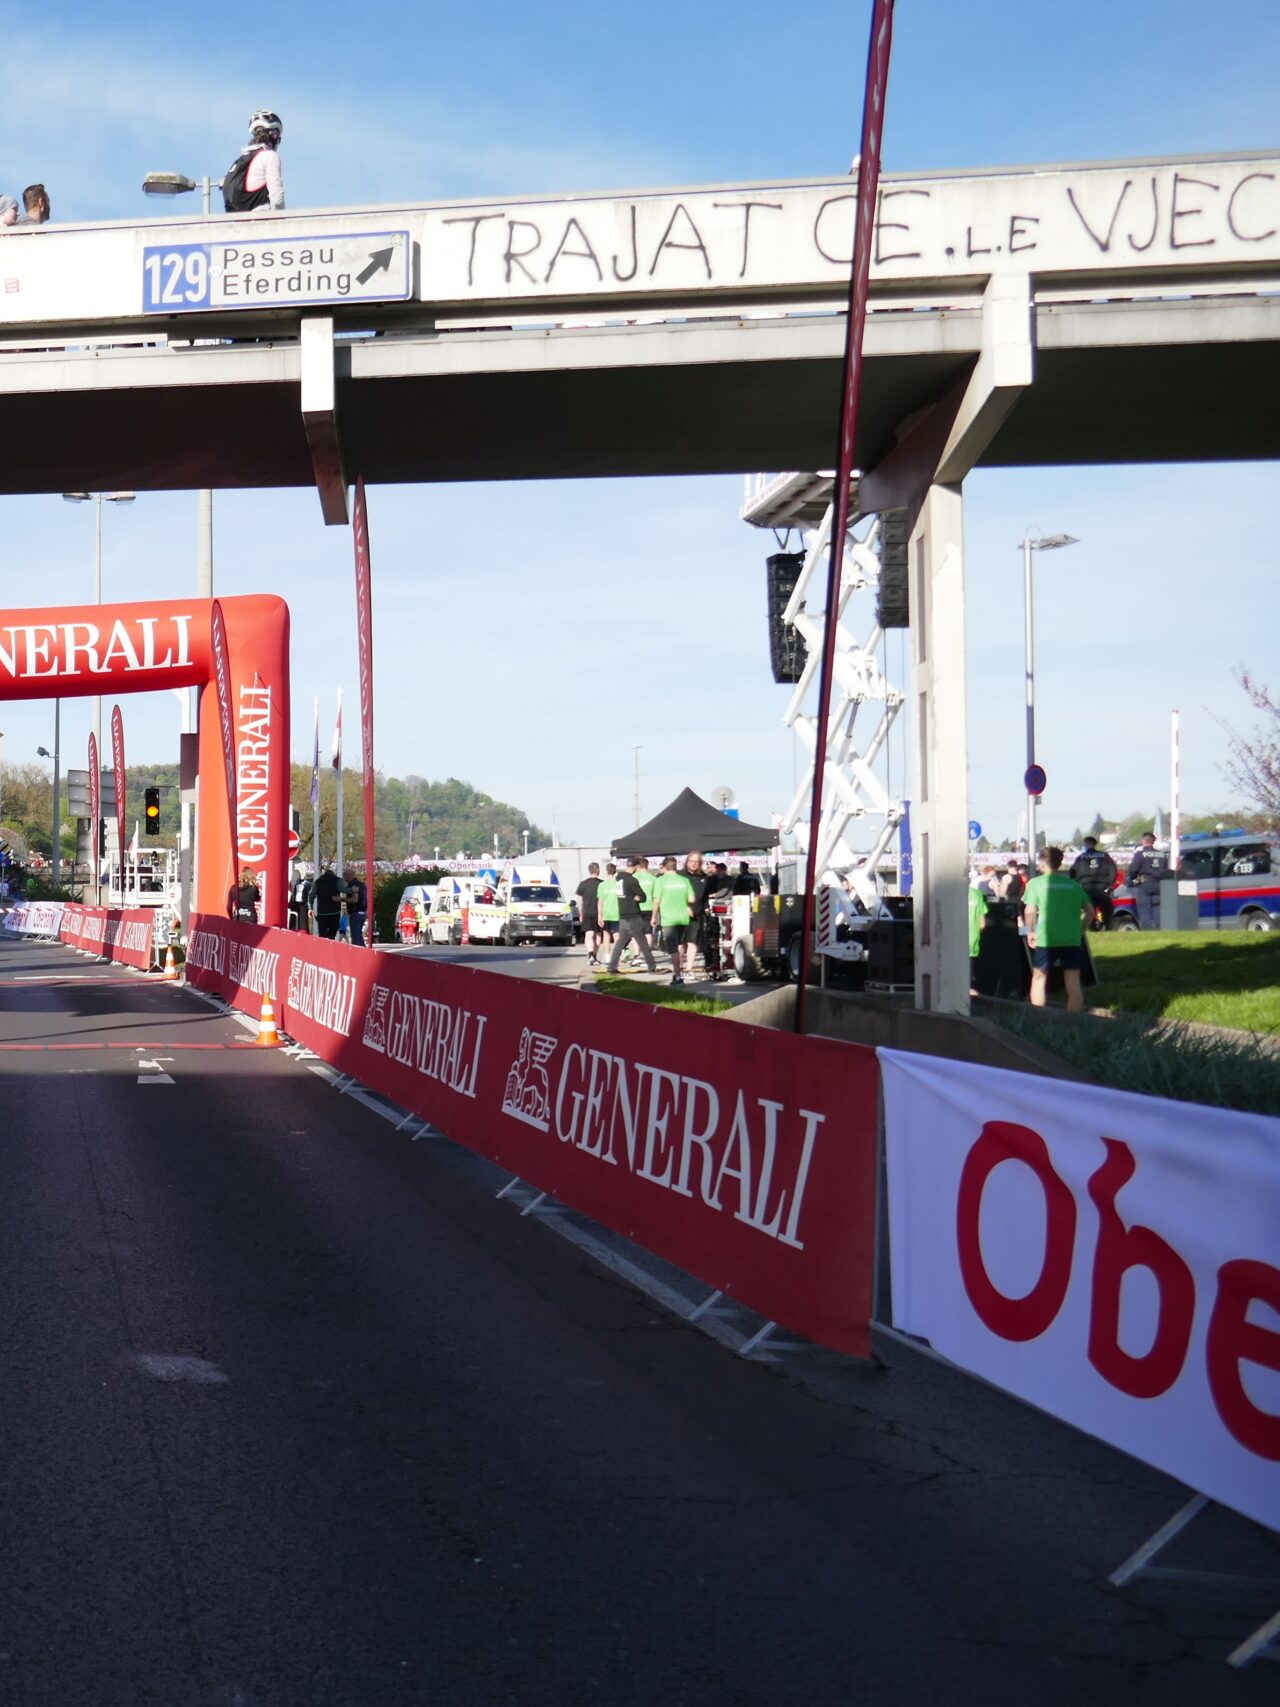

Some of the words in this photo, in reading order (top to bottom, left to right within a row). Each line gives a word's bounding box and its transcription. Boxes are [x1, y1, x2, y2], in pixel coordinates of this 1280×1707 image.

[145, 252, 207, 304] 129
[223, 247, 335, 270] Passau
[223, 270, 351, 297] Eferding
[442, 202, 783, 286] TRAJAT
[238, 684, 271, 862] GENERALI
[449, 861, 493, 870] Oberbank
[237, 943, 280, 1000] GENERALI
[300, 961, 357, 1038] GENERALI
[386, 991, 487, 1098] GENERALI
[555, 1043, 826, 1251] GENERALI
[956, 1120, 1280, 1462] Obe
